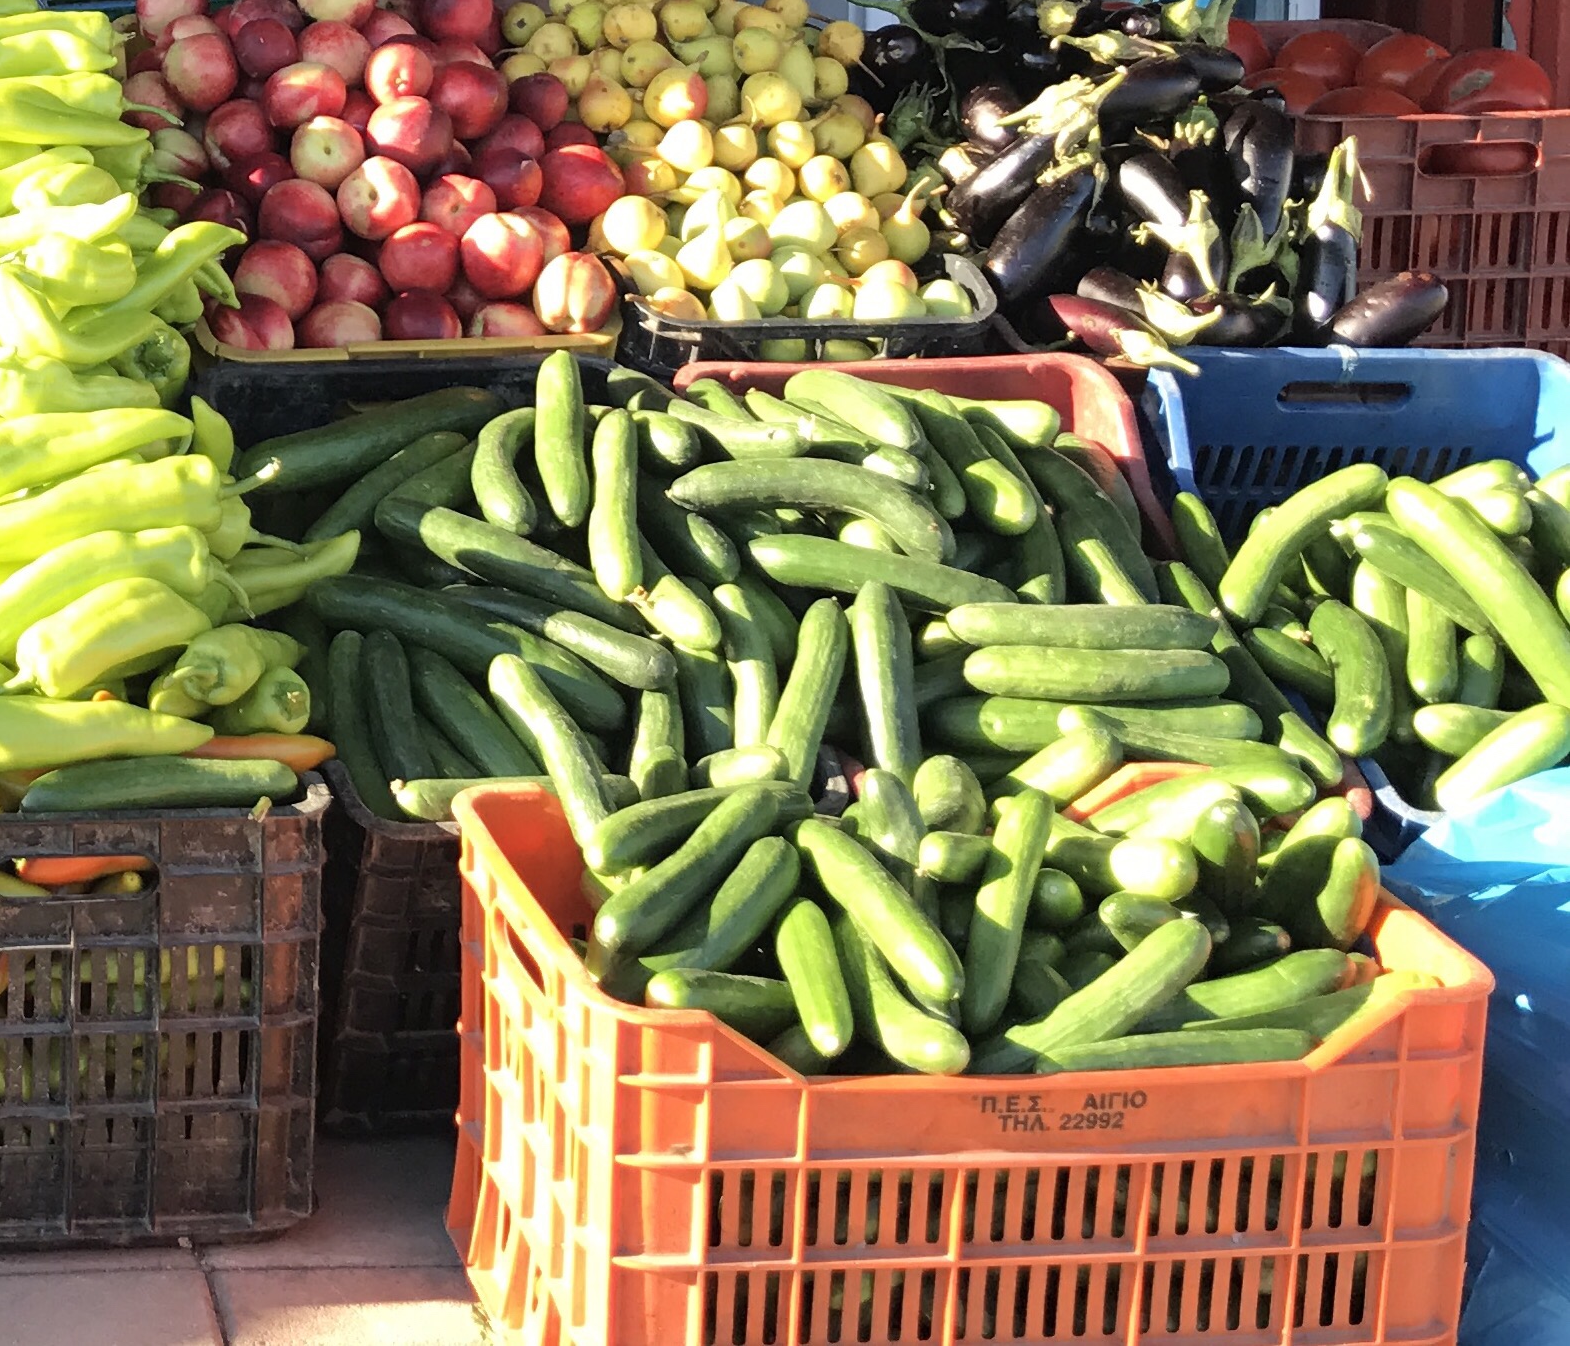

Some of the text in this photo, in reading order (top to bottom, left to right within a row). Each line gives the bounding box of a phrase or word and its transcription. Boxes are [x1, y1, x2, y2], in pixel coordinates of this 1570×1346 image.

[1081, 1090, 1148, 1111] ΑΙΓΙΟ
[998, 1111, 1125, 1133] ΤΗΛ. 22992
